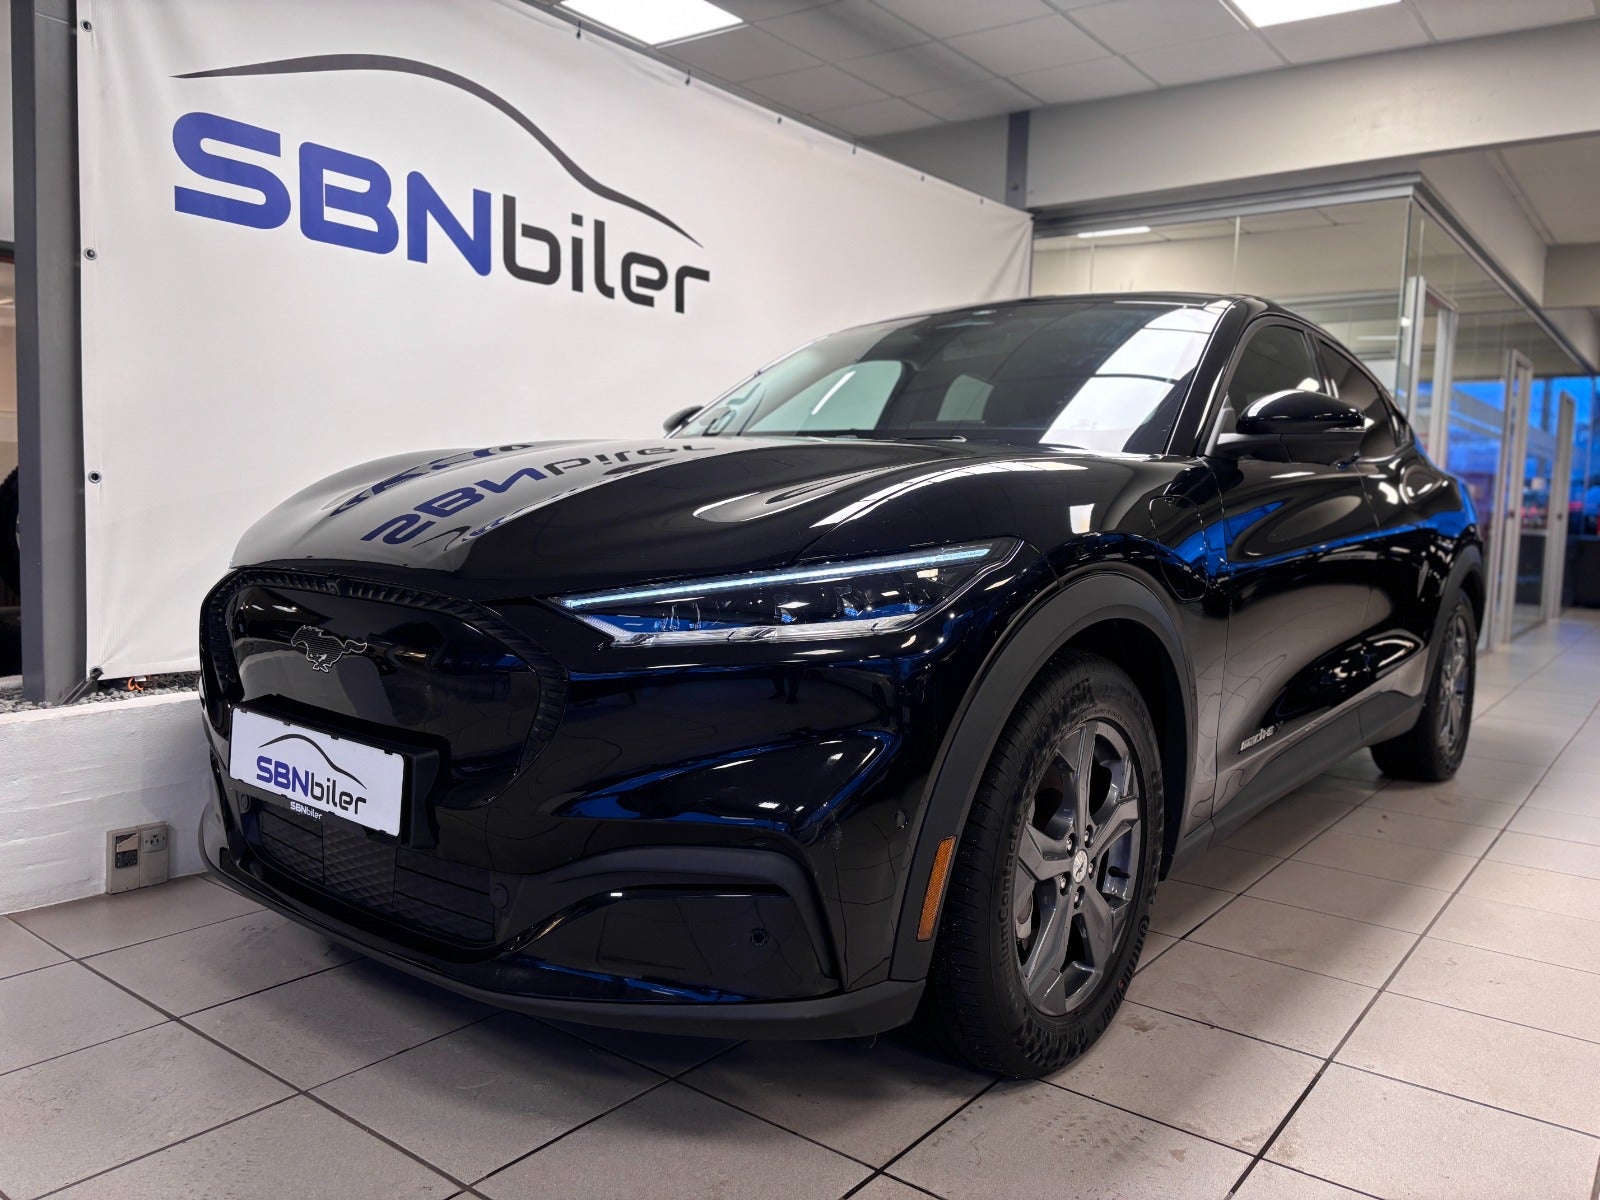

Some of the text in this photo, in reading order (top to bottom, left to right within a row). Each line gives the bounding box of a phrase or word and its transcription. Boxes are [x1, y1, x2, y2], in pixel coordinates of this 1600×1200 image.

[172, 112, 710, 314] SBNbiler
[256, 756, 366, 814] SBNbiler
[290, 802, 322, 819] SBNbiler
